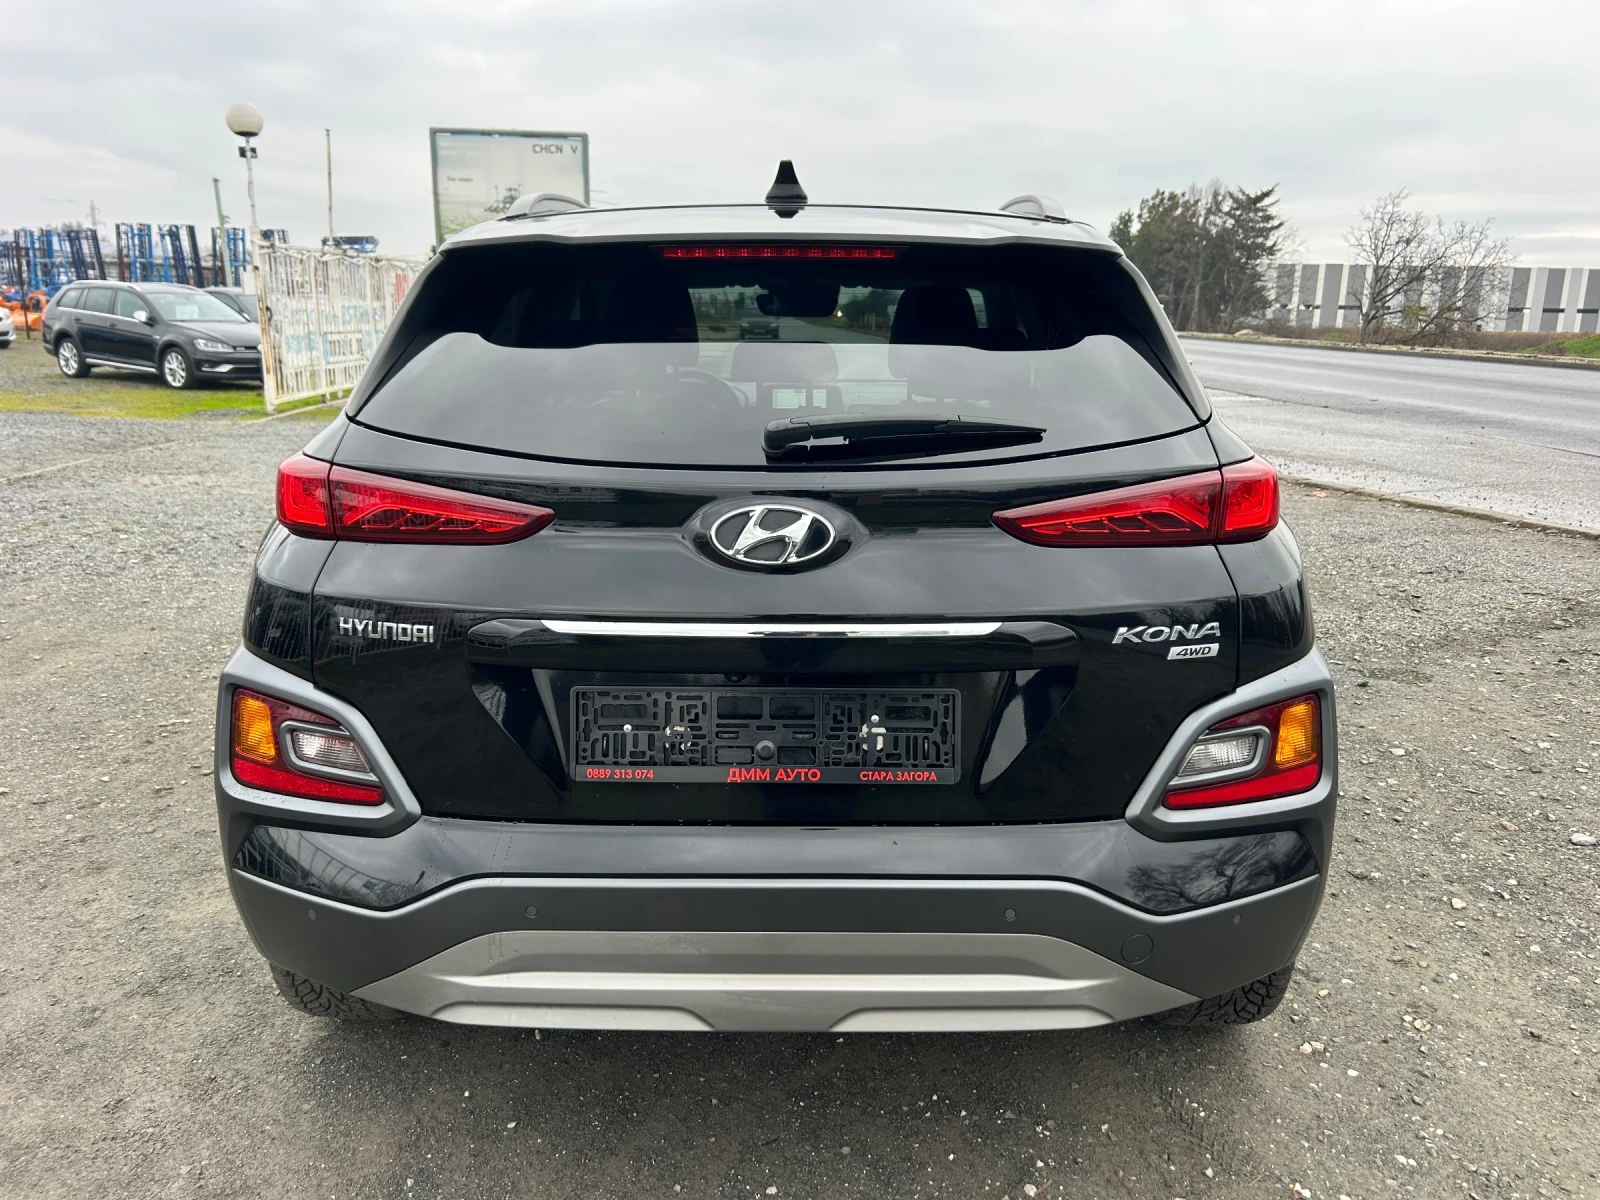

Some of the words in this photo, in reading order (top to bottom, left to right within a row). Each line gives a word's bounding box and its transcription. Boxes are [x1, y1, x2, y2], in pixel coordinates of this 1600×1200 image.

[339, 617, 434, 642] HYUNDAI
[1111, 622, 1221, 644] KONA
[1175, 646, 1212, 657] 4WD
[586, 768, 610, 779] 0889
[614, 769, 633, 779] 313
[635, 769, 654, 779] 074
[727, 768, 770, 783] ДММ
[775, 768, 821, 782] АУТО
[859, 771, 894, 781] СТАРА
[896, 771, 937, 781] ЗАГОРА
